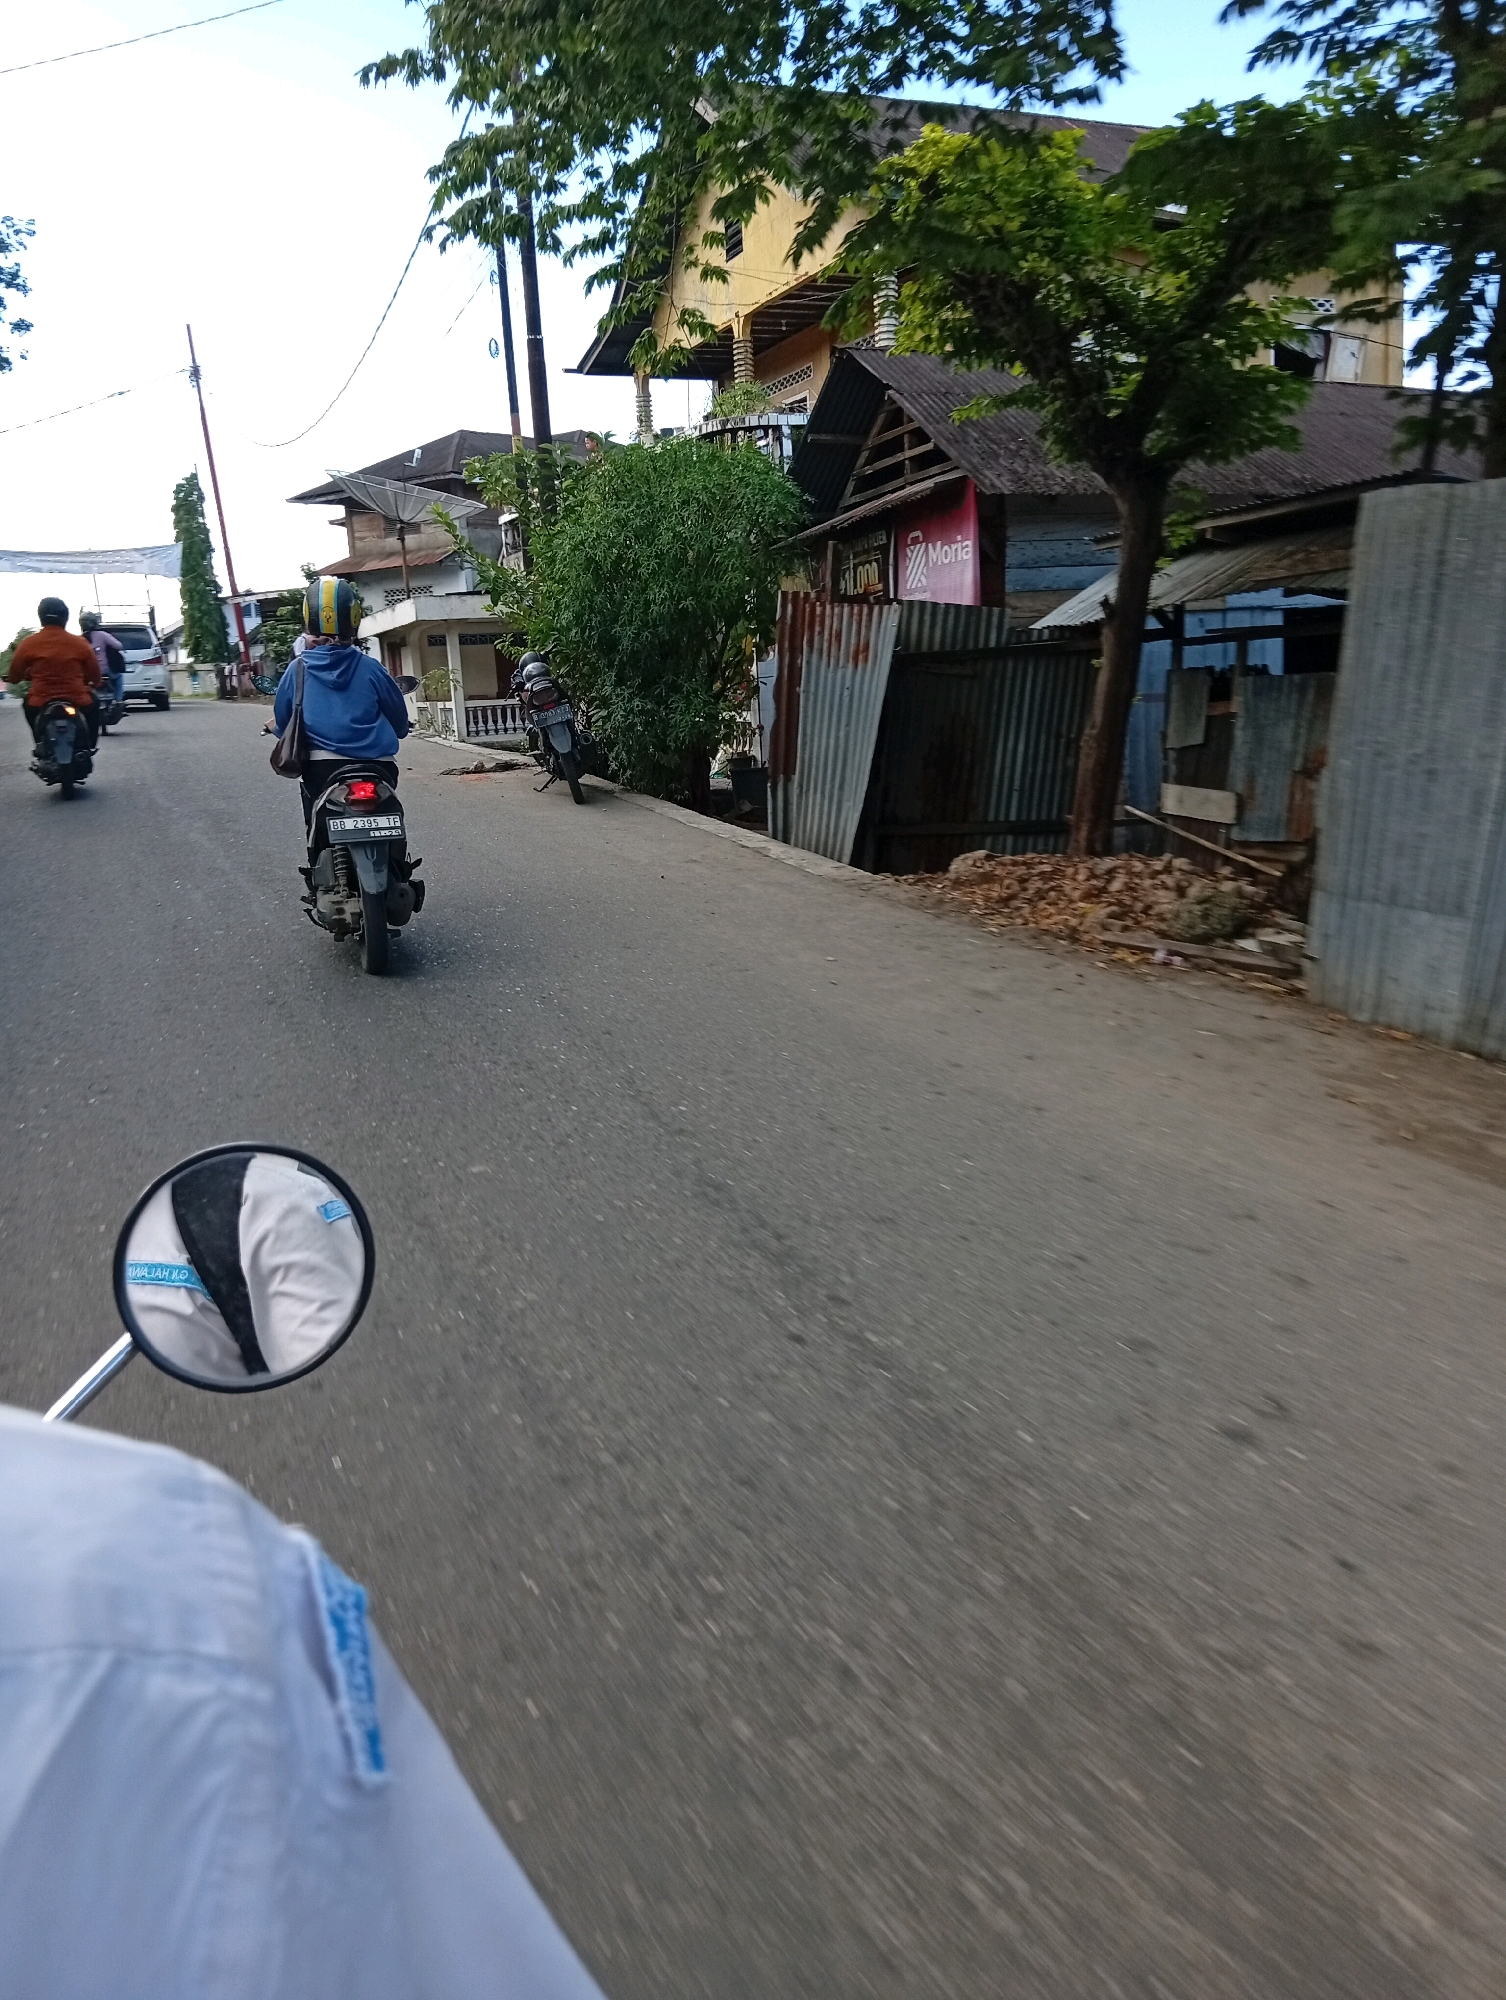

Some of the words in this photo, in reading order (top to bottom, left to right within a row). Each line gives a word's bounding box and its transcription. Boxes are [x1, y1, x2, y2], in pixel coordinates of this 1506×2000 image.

[928, 535, 973, 568] Moria
[332, 820, 346, 830] BB
[353, 818, 379, 829] 2395
